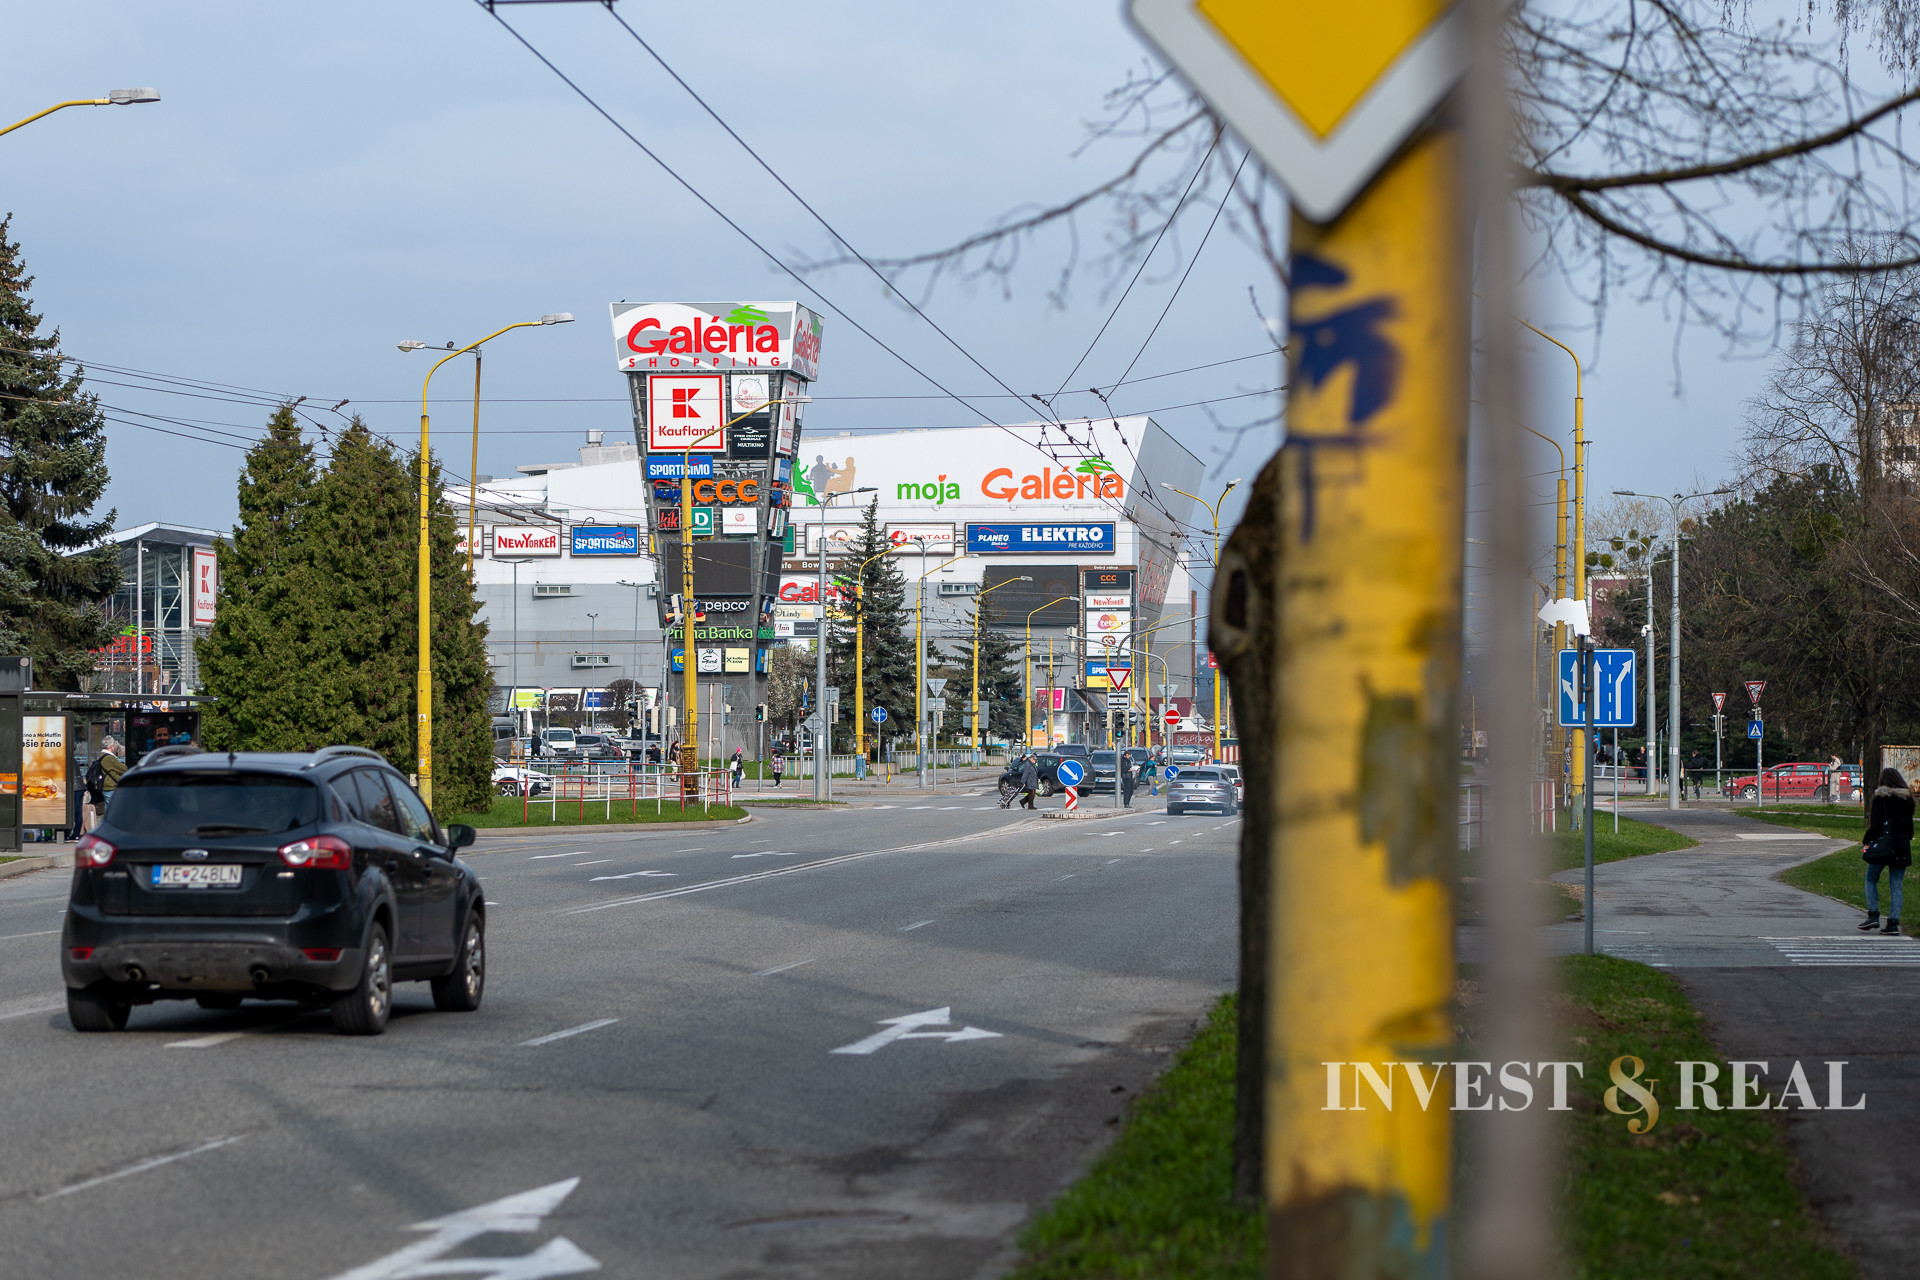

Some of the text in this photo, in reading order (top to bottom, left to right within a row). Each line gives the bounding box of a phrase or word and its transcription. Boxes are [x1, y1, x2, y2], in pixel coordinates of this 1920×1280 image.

[627, 316, 779, 356] Galéria
[795, 319, 819, 364] Galéria
[629, 357, 780, 367] SHOPPING
[659, 425, 715, 436] Kaufland
[650, 464, 710, 475] SPORTISIMO
[694, 479, 758, 502] CCC
[897, 466, 1123, 504] moja Galéria
[978, 534, 1009, 542] PLANEO
[1022, 527, 1103, 541] ELEKTRO
[575, 537, 635, 549] SPORTISIMO
[802, 561, 834, 569] Bowng
[198, 600, 213, 610] Kaufland
[665, 625, 753, 639] Pria Banka
[41, 739, 62, 747] ráno
[162, 867, 239, 882] KE 248LN
